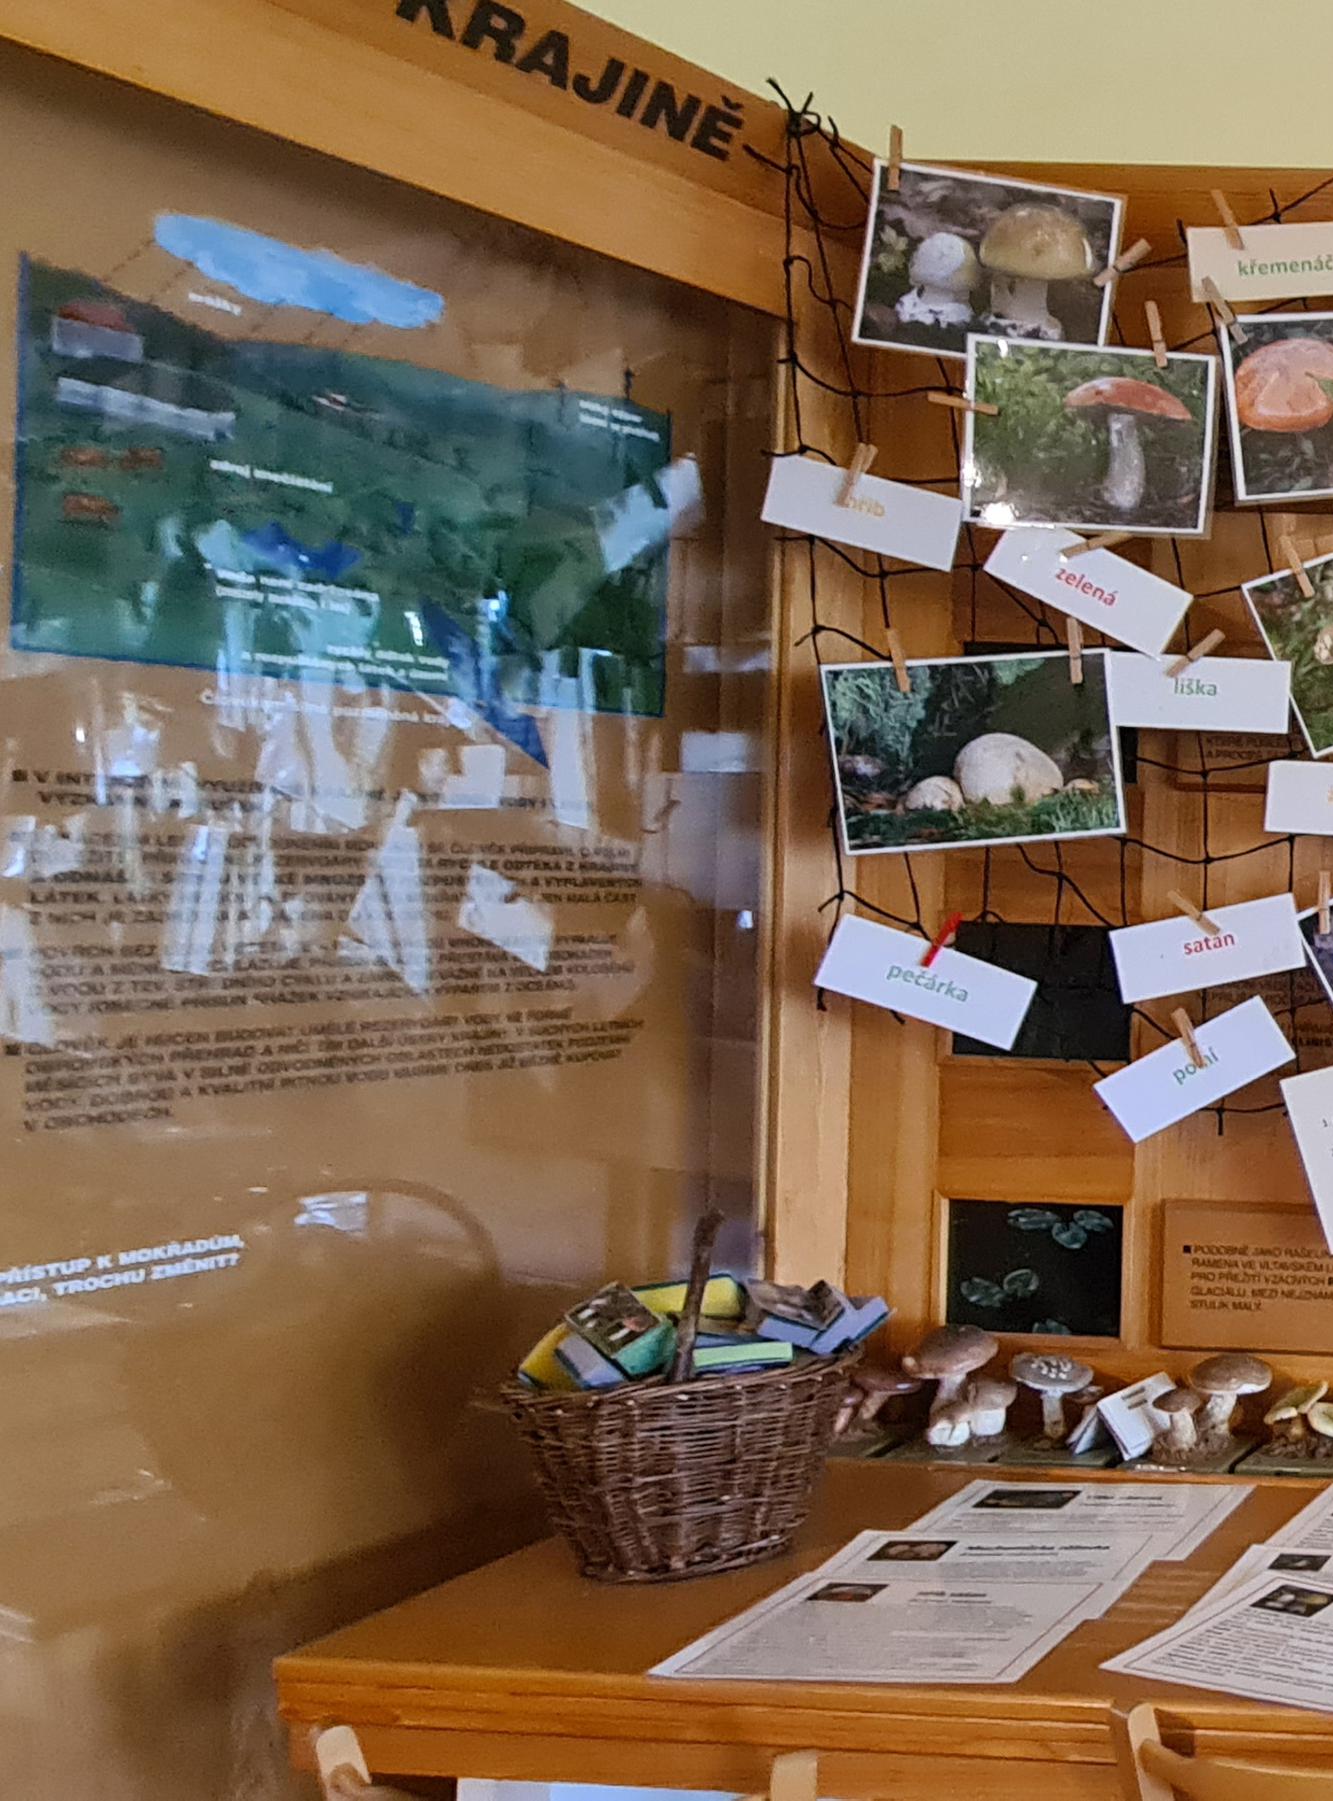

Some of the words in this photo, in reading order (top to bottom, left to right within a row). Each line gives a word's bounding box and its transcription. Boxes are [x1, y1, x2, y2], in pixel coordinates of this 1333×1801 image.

[395, 0, 744, 161] KRAJINĚ
[1055, 566, 1118, 607] zelená
[1172, 676, 1218, 697] liška
[1183, 931, 1236, 956] satan
[886, 962, 969, 1004] pečárka
[1173, 1047, 1218, 1085] poní
[97, 1256, 112, 1269] K
[53, 1268, 146, 1297] TROCHU
